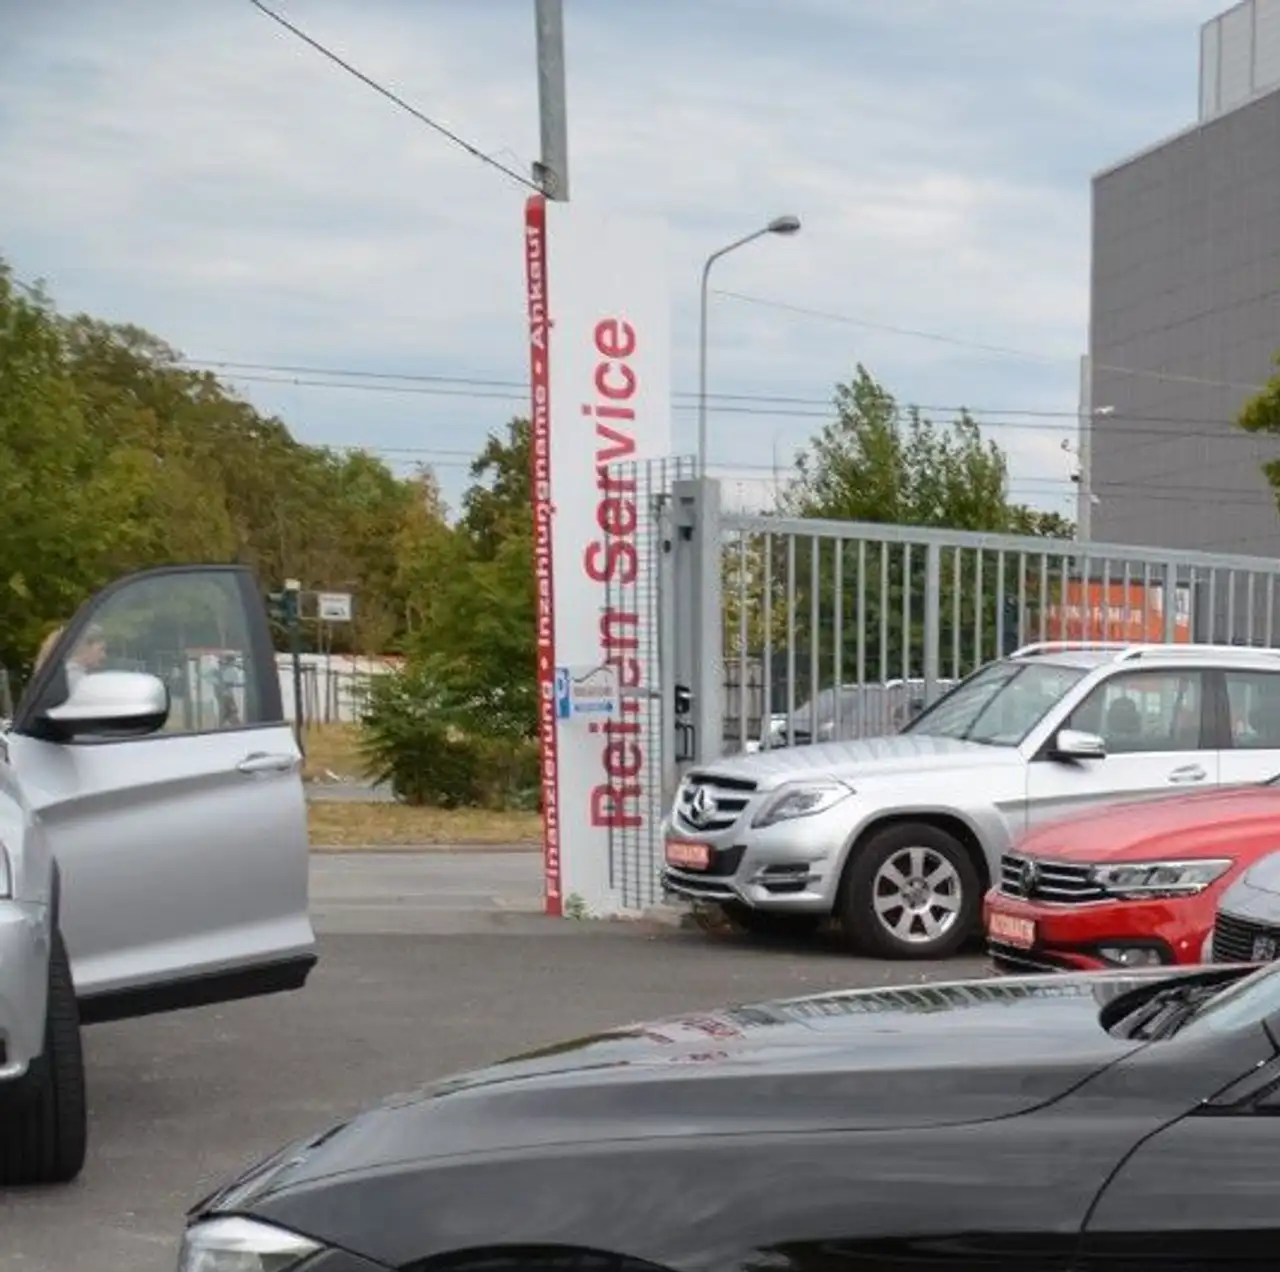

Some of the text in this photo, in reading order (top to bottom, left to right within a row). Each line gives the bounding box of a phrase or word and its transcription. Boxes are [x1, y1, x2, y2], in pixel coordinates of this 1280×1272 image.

[527, 223, 547, 350] Ankauf
[581, 318, 640, 585] Service
[589, 608, 643, 829] Reien
